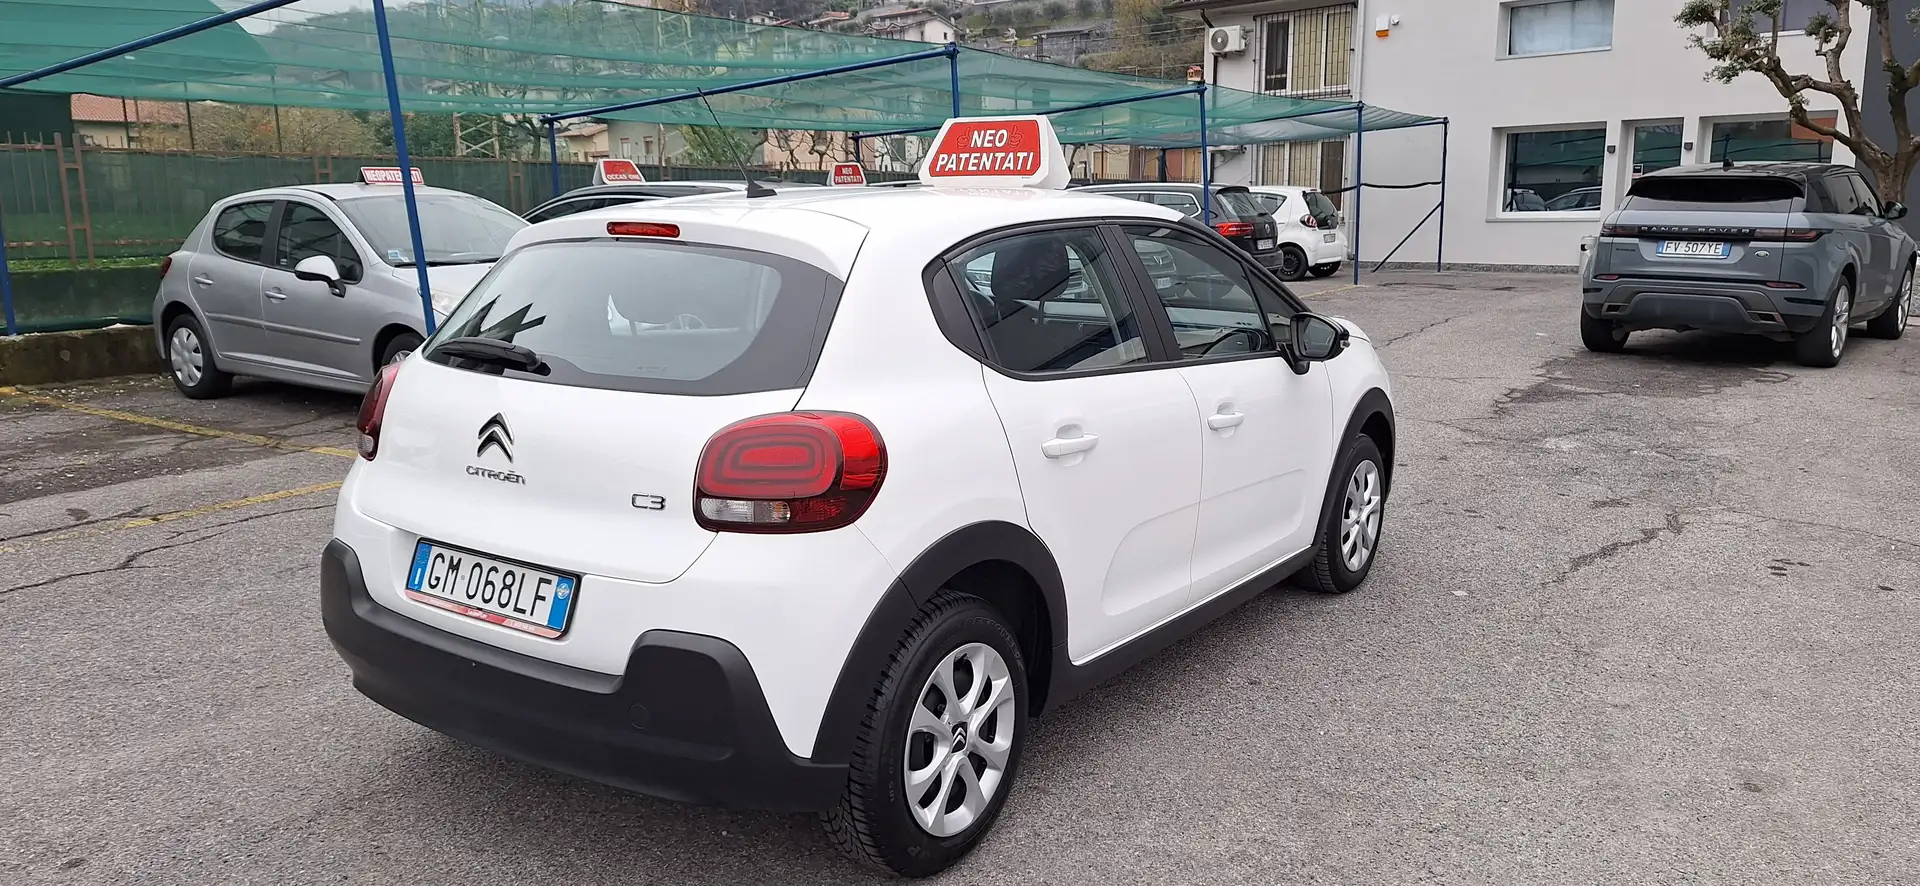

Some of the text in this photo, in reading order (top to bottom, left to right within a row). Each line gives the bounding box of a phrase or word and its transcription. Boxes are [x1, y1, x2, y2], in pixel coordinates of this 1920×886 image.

[970, 129, 1008, 148] NEO
[841, 167, 853, 175] NEO
[935, 152, 1034, 172] PATENTATI
[834, 175, 863, 184] PATENTATI
[1665, 242, 1682, 253] FV
[1684, 242, 1722, 254] 507YE
[631, 492, 666, 511] C3
[428, 552, 462, 595] GM
[465, 561, 552, 617] 068LF
